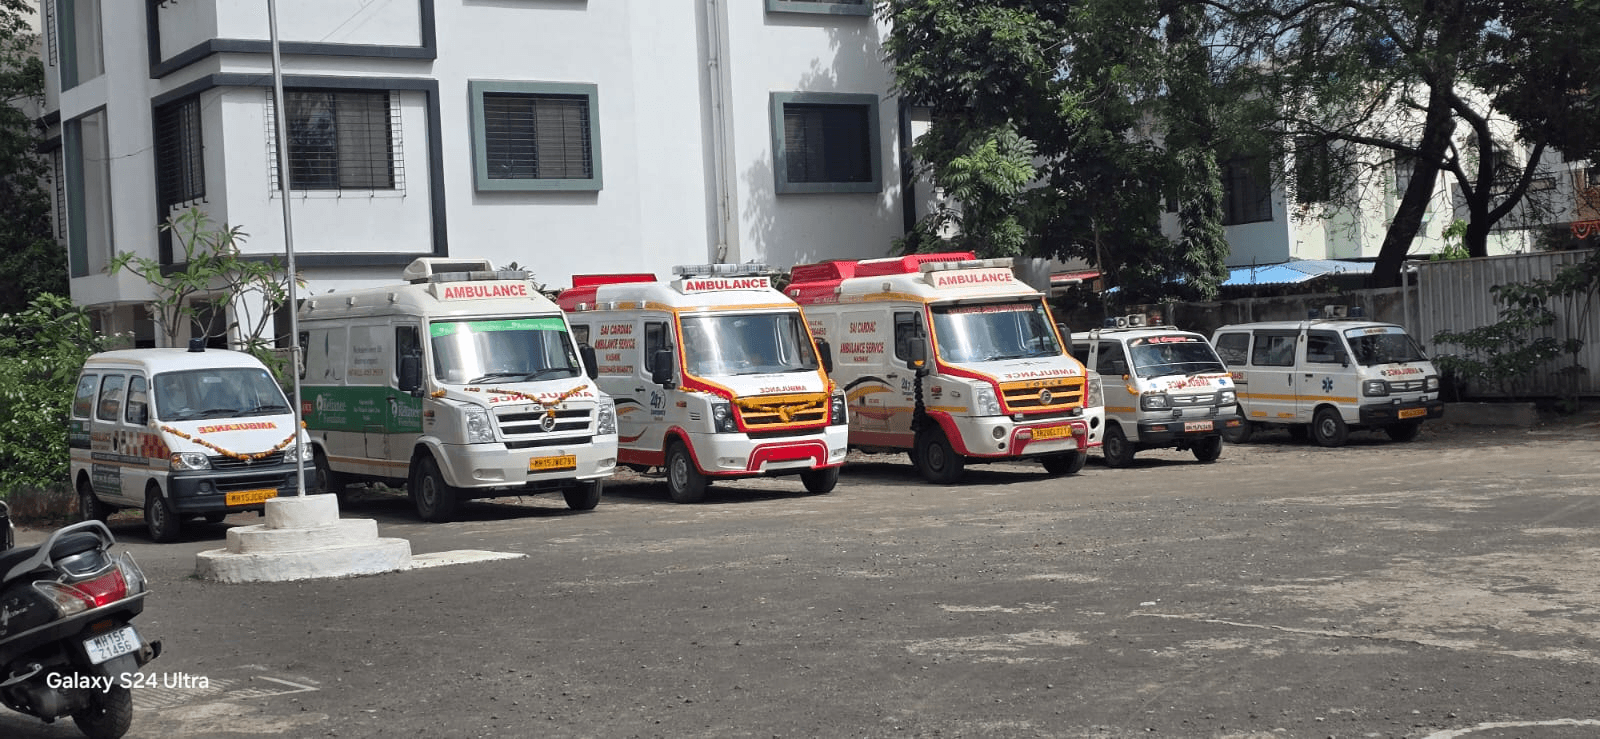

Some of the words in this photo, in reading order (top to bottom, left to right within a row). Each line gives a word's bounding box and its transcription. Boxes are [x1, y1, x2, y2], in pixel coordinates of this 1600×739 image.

[685, 278, 769, 291] AMBULANCE
[938, 272, 1013, 286] AMBULANCE
[444, 284, 528, 299] AMBULANCE
[600, 325, 609, 335] SAI
[610, 324, 632, 335] CARDIAC
[849, 322, 857, 333] SAI
[858, 321, 876, 333] CARDIAC
[840, 342, 865, 353] AMBULANCE
[866, 342, 884, 353] SERVICE
[1025, 379, 1063, 388] FORCE
[94, 629, 125, 649] MH15F
[99, 640, 131, 659] Z1456
